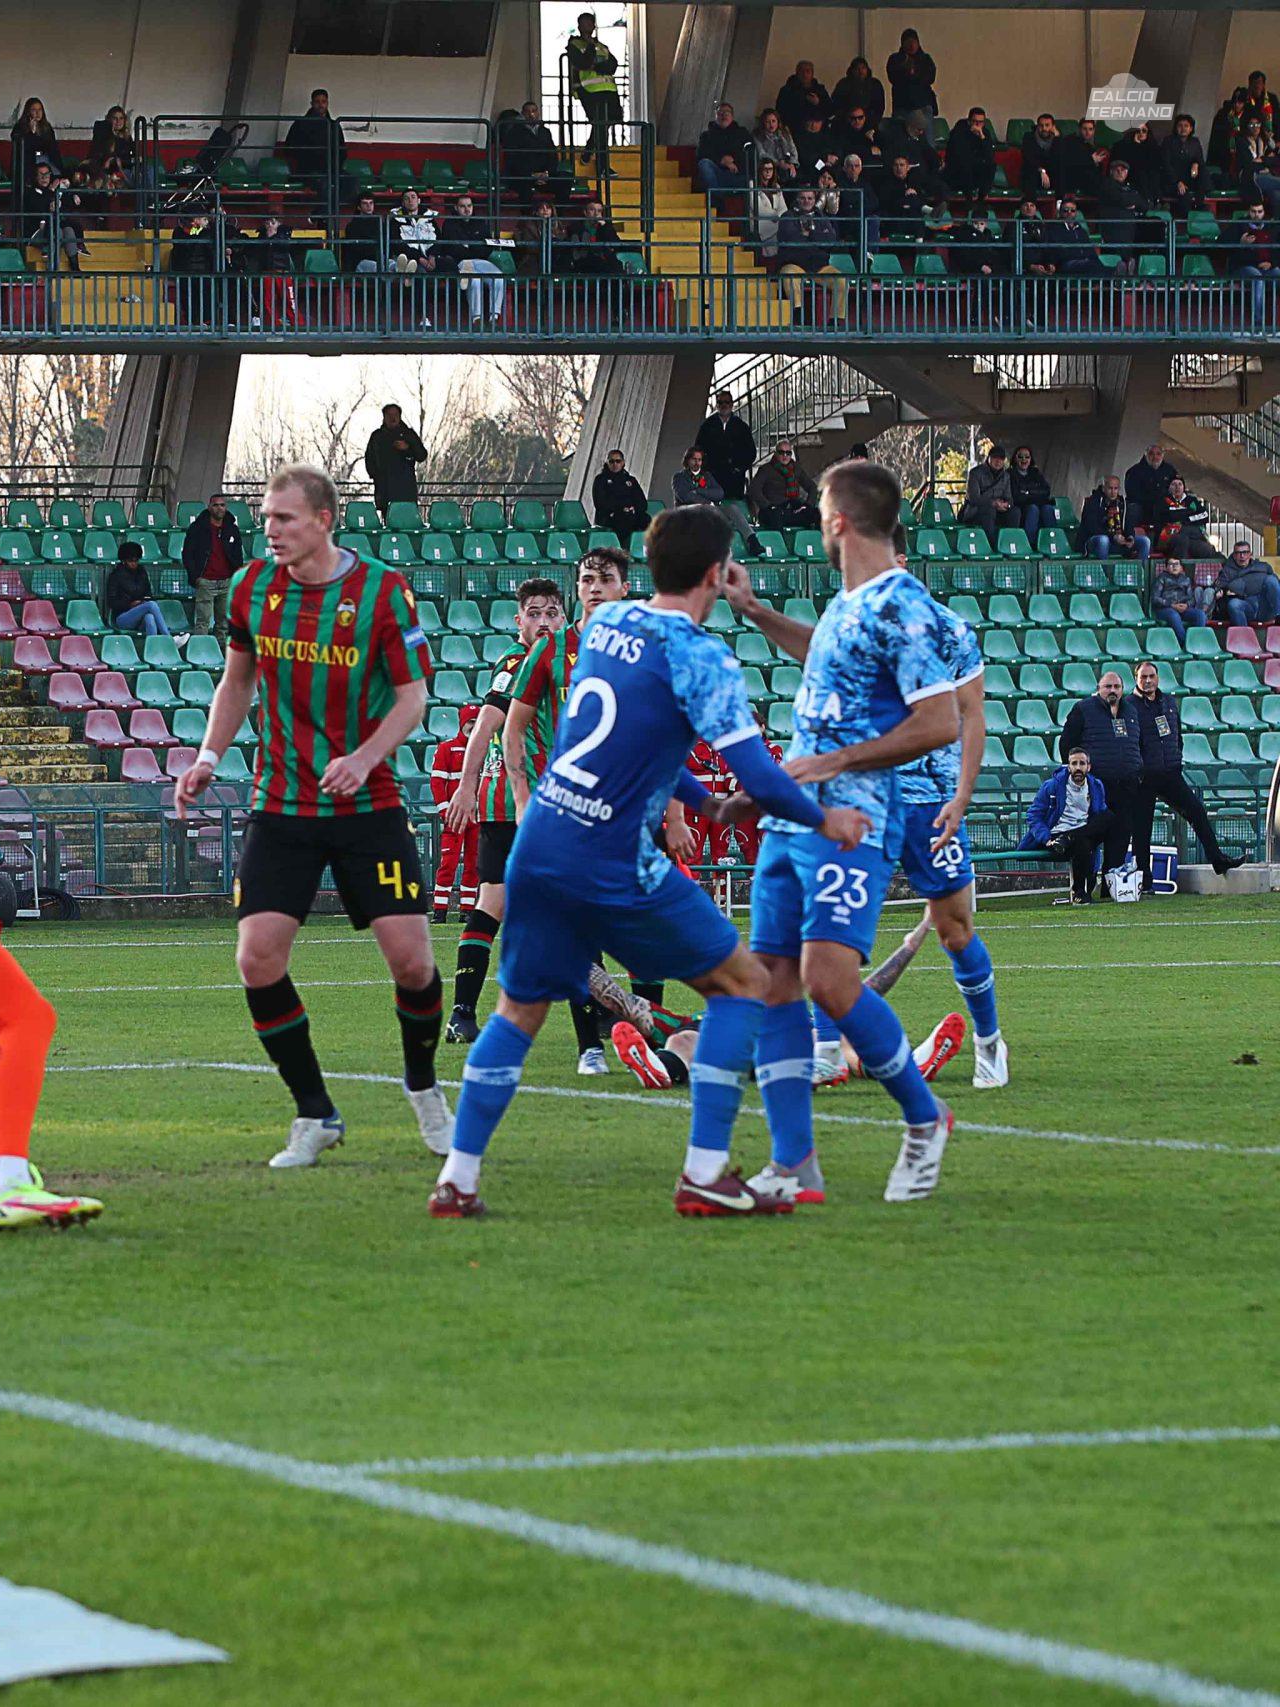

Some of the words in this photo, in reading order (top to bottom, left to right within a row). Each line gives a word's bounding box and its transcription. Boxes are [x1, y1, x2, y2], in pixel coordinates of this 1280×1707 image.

[255, 633, 360, 668] UNICUSANO
[550, 676, 618, 790] 2
[929, 835, 965, 869] 26
[377, 860, 404, 900] 4
[813, 862, 870, 910] 23
